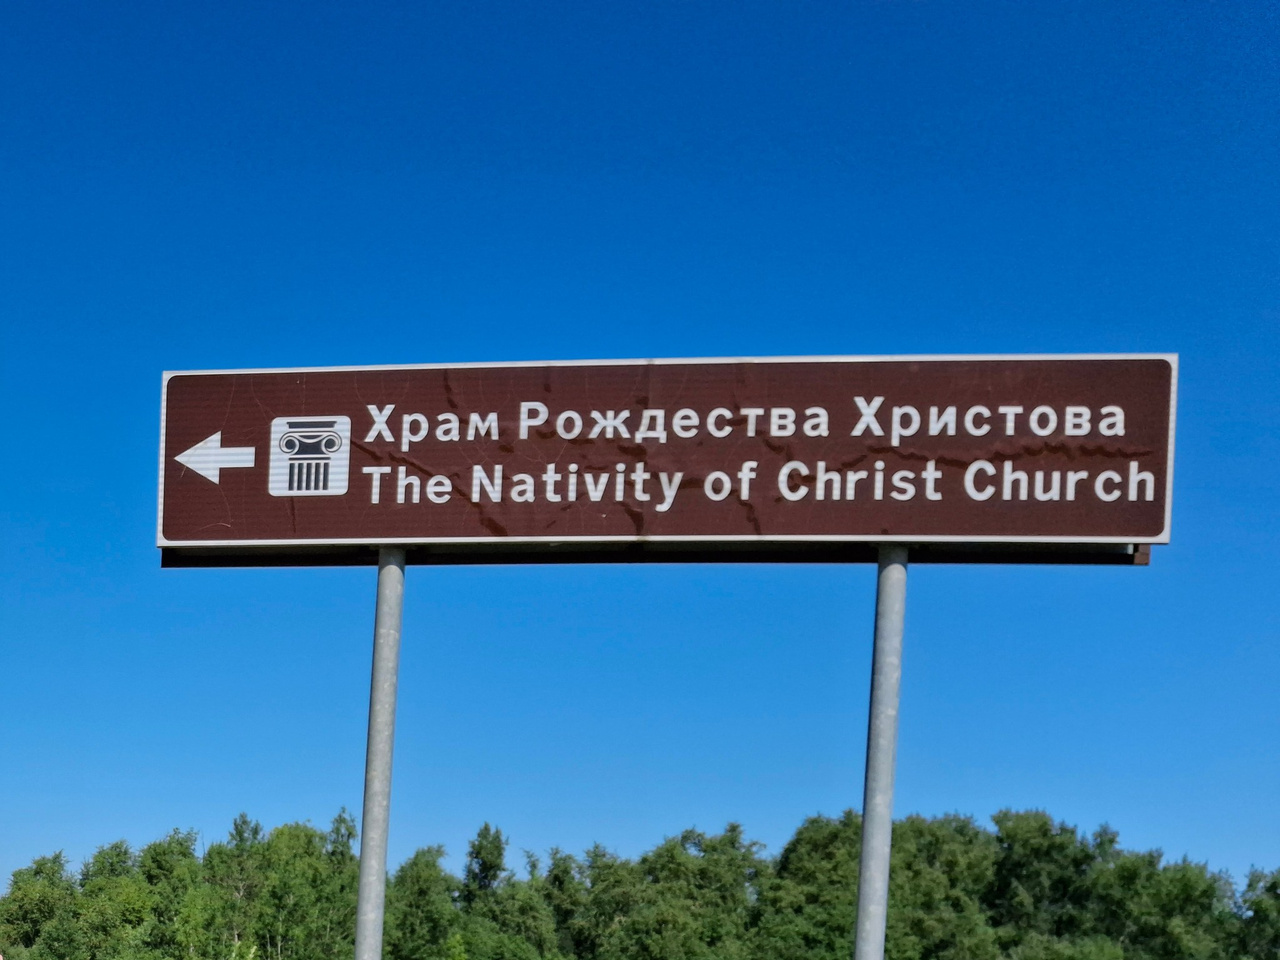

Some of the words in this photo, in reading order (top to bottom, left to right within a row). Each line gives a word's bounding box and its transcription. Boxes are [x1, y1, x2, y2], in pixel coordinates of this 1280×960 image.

[363, 404, 499, 452] Храм
[519, 401, 830, 444] Рождества
[850, 396, 1126, 447] Христова
[362, 465, 453, 504] The
[471, 462, 684, 512] Nativity
[704, 460, 758, 501] of
[778, 460, 943, 501] Christ
[963, 460, 1155, 502] Church
